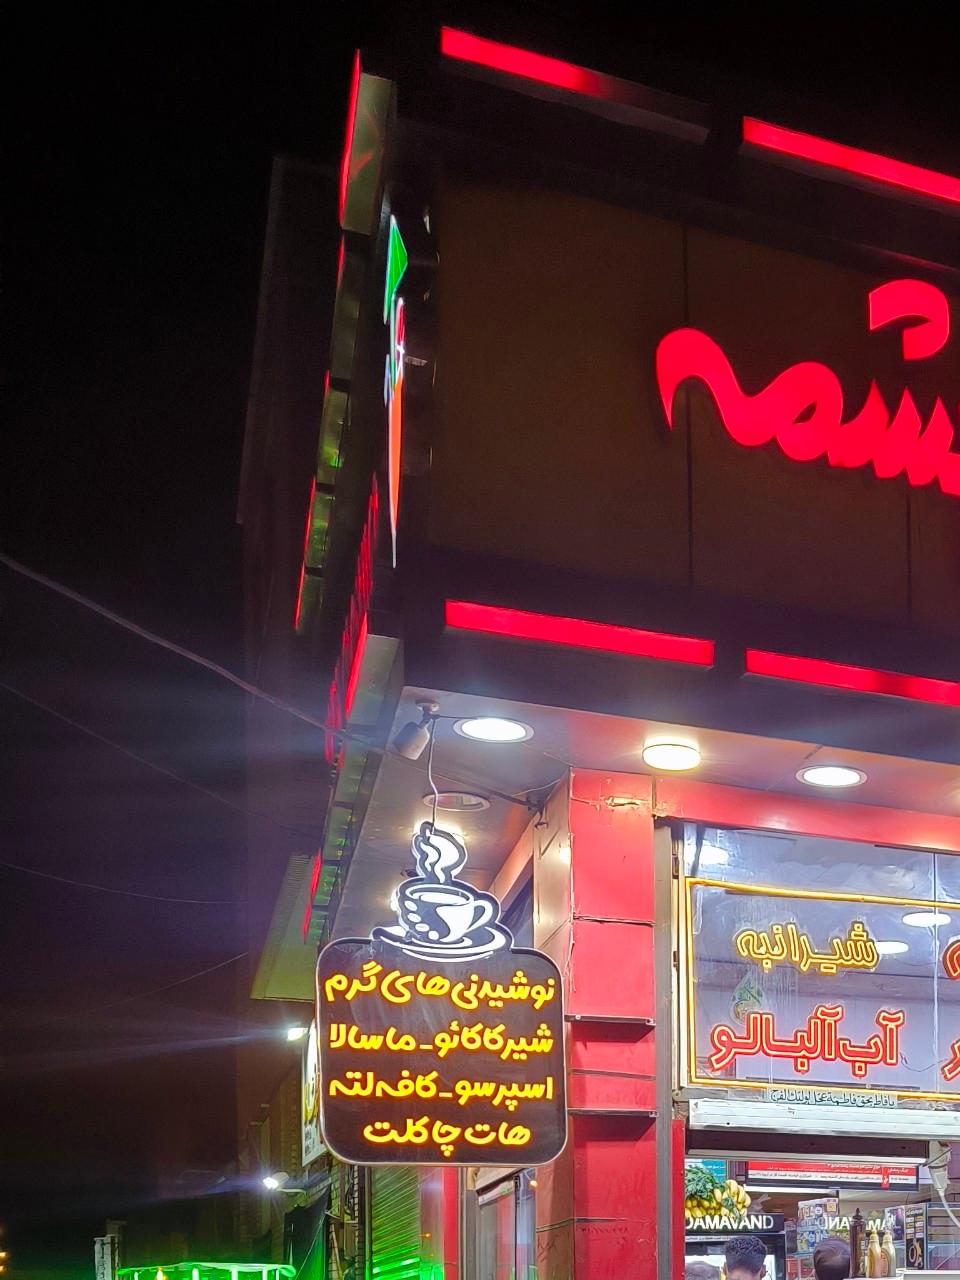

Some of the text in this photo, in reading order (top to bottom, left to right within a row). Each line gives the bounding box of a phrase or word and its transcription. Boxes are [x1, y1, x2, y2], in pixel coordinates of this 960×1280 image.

[324, 961, 555, 1010] نوشیدنی های گرم
[329, 1023, 416, 1051] ماسالا
[709, 1006, 904, 1077] آب آلبالو
[454, 1076, 554, 1111] اسپرسو
[363, 1116, 531, 1157] هات چاکلت
